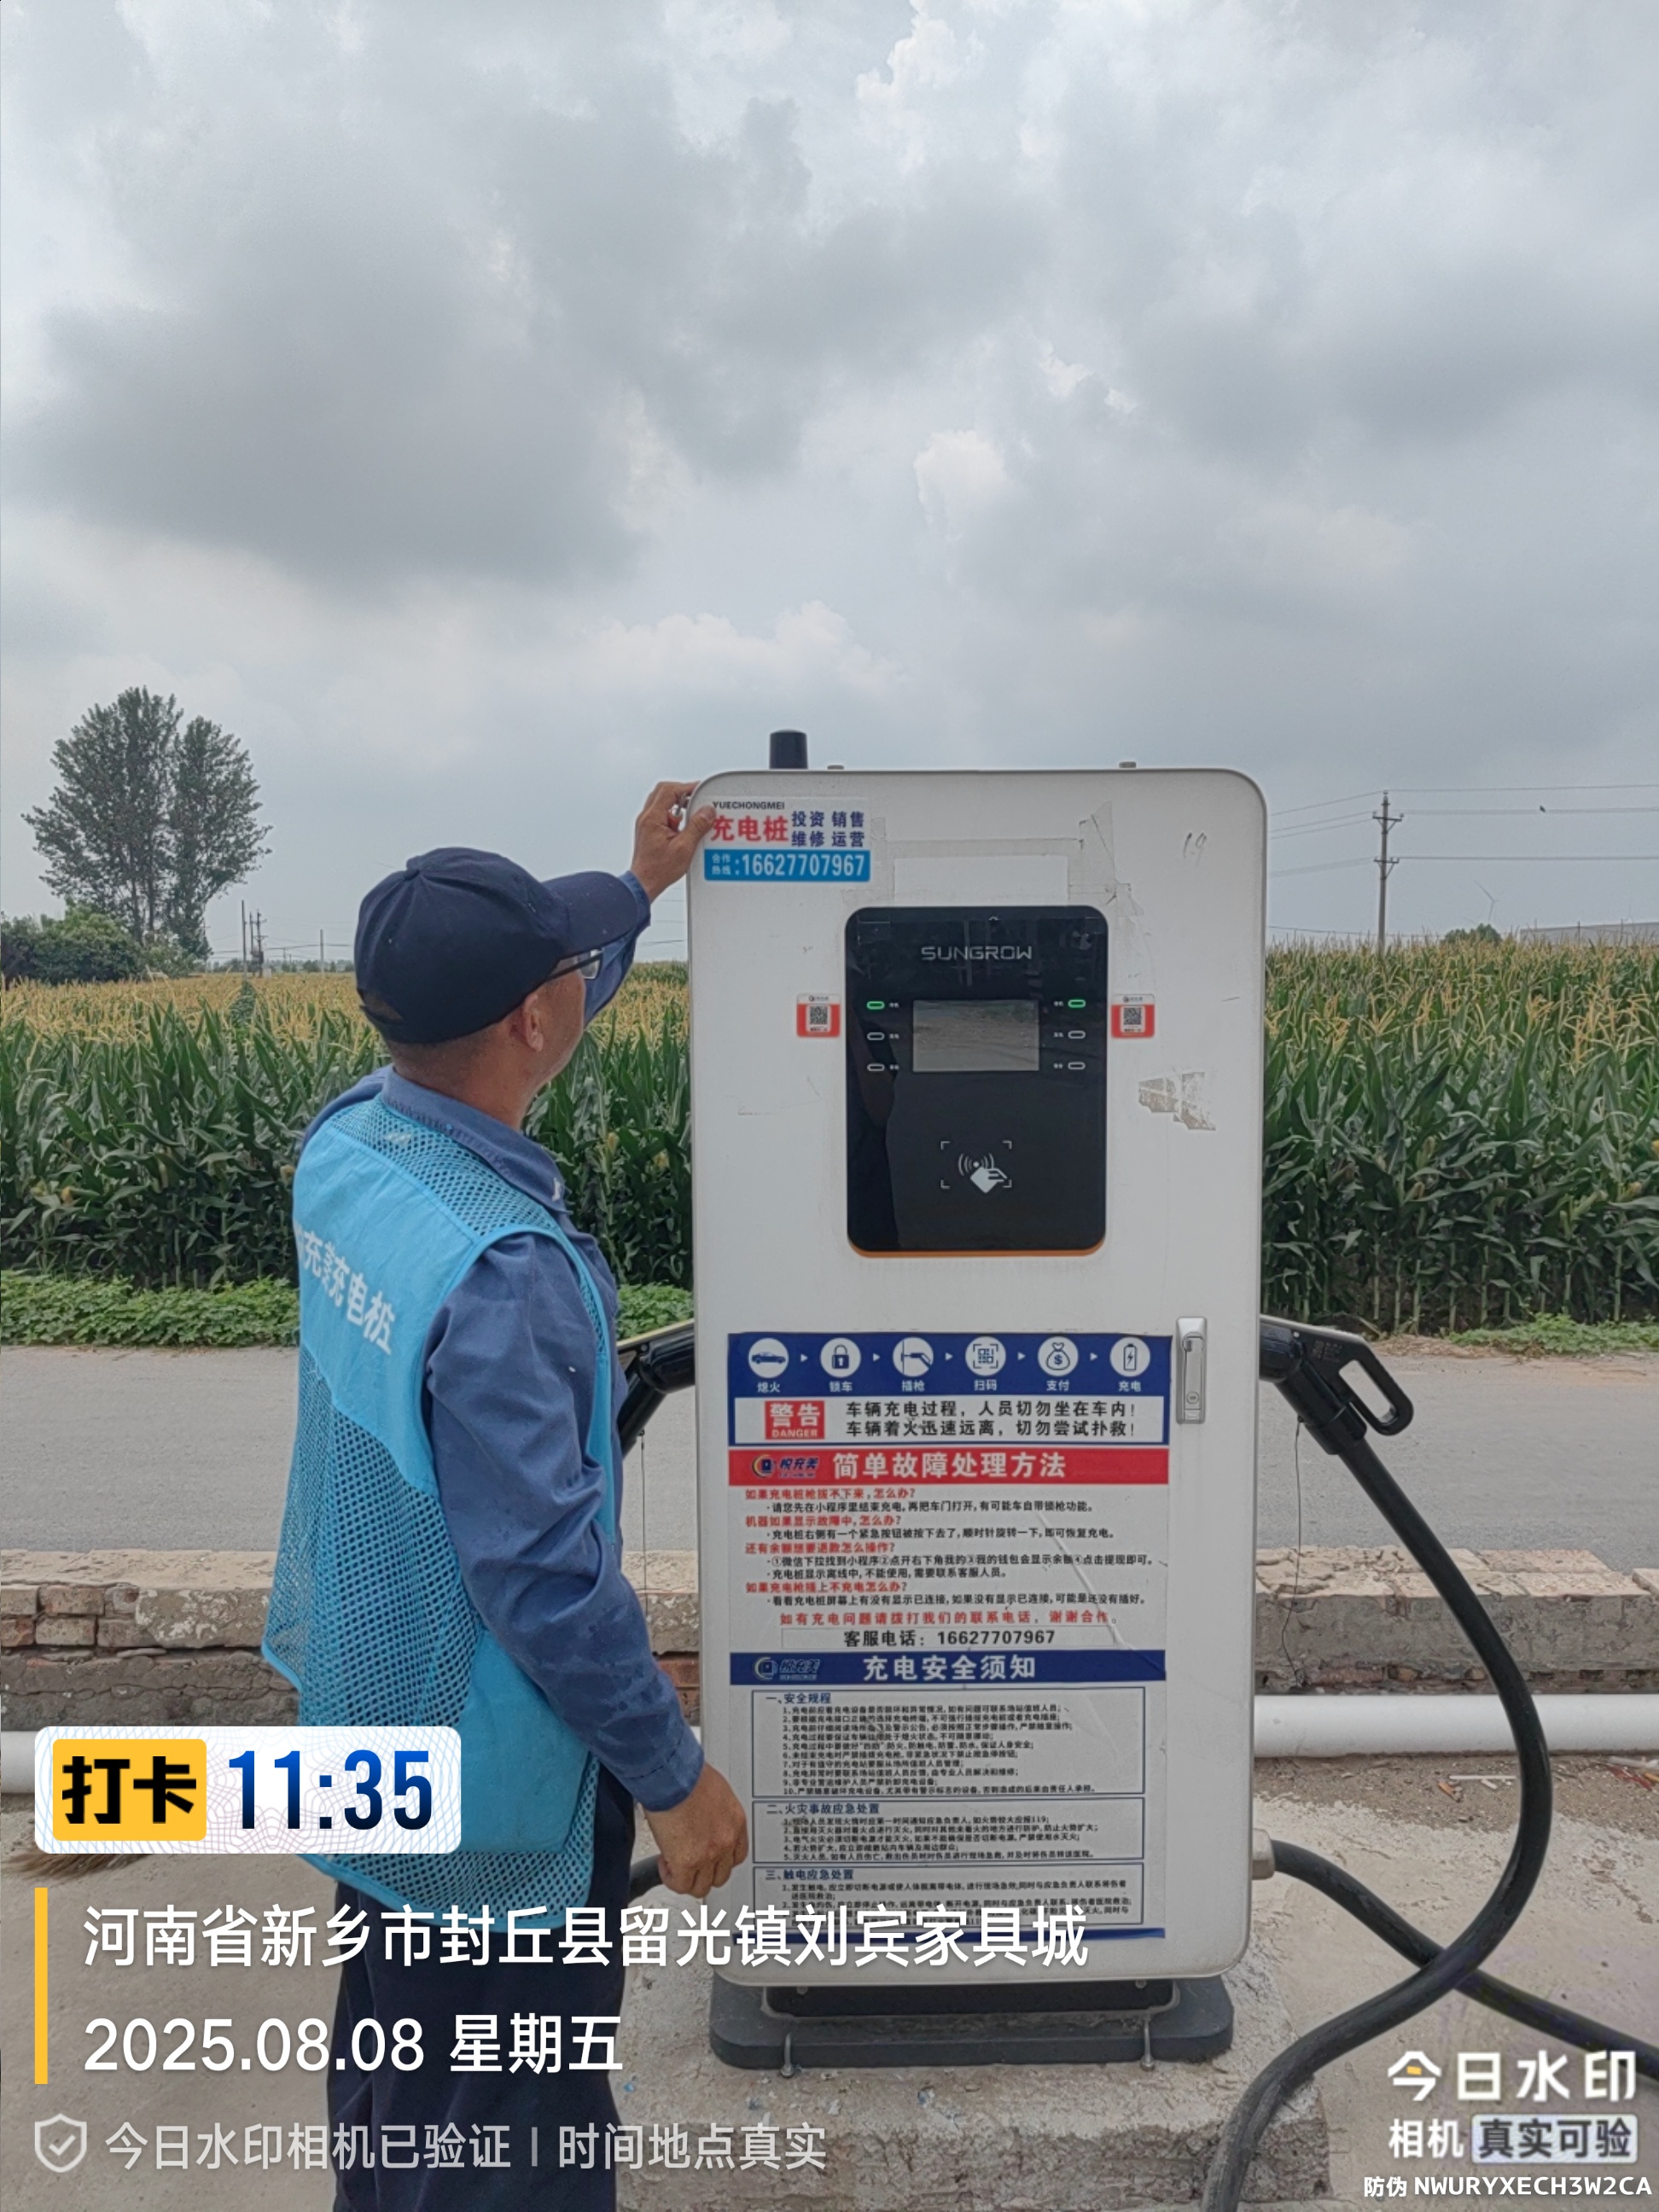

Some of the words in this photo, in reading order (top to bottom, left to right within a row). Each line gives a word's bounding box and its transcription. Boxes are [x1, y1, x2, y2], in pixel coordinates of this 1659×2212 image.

[712, 801, 785, 810] YUECHONGMEI
[791, 810, 825, 828] 投资
[831, 810, 865, 828] 销售
[711, 815, 789, 842] 充电桩
[791, 830, 825, 847] 维修
[831, 830, 865, 847] 运营
[921, 946, 1033, 960] SUNGROW
[757, 1381, 780, 1393] 熄火
[830, 1380, 853, 1392] 锁车
[902, 1379, 924, 1392] 插枪
[974, 1379, 997, 1391] 扫码
[1046, 1379, 1069, 1391] 支付
[1118, 1379, 1141, 1392] 充电
[770, 1402, 820, 1427] 警告
[771, 1429, 818, 1438] DANGER
[833, 1453, 1066, 1478] 简单故障处理方法
[864, 1655, 1036, 1681] 充电安全须知
